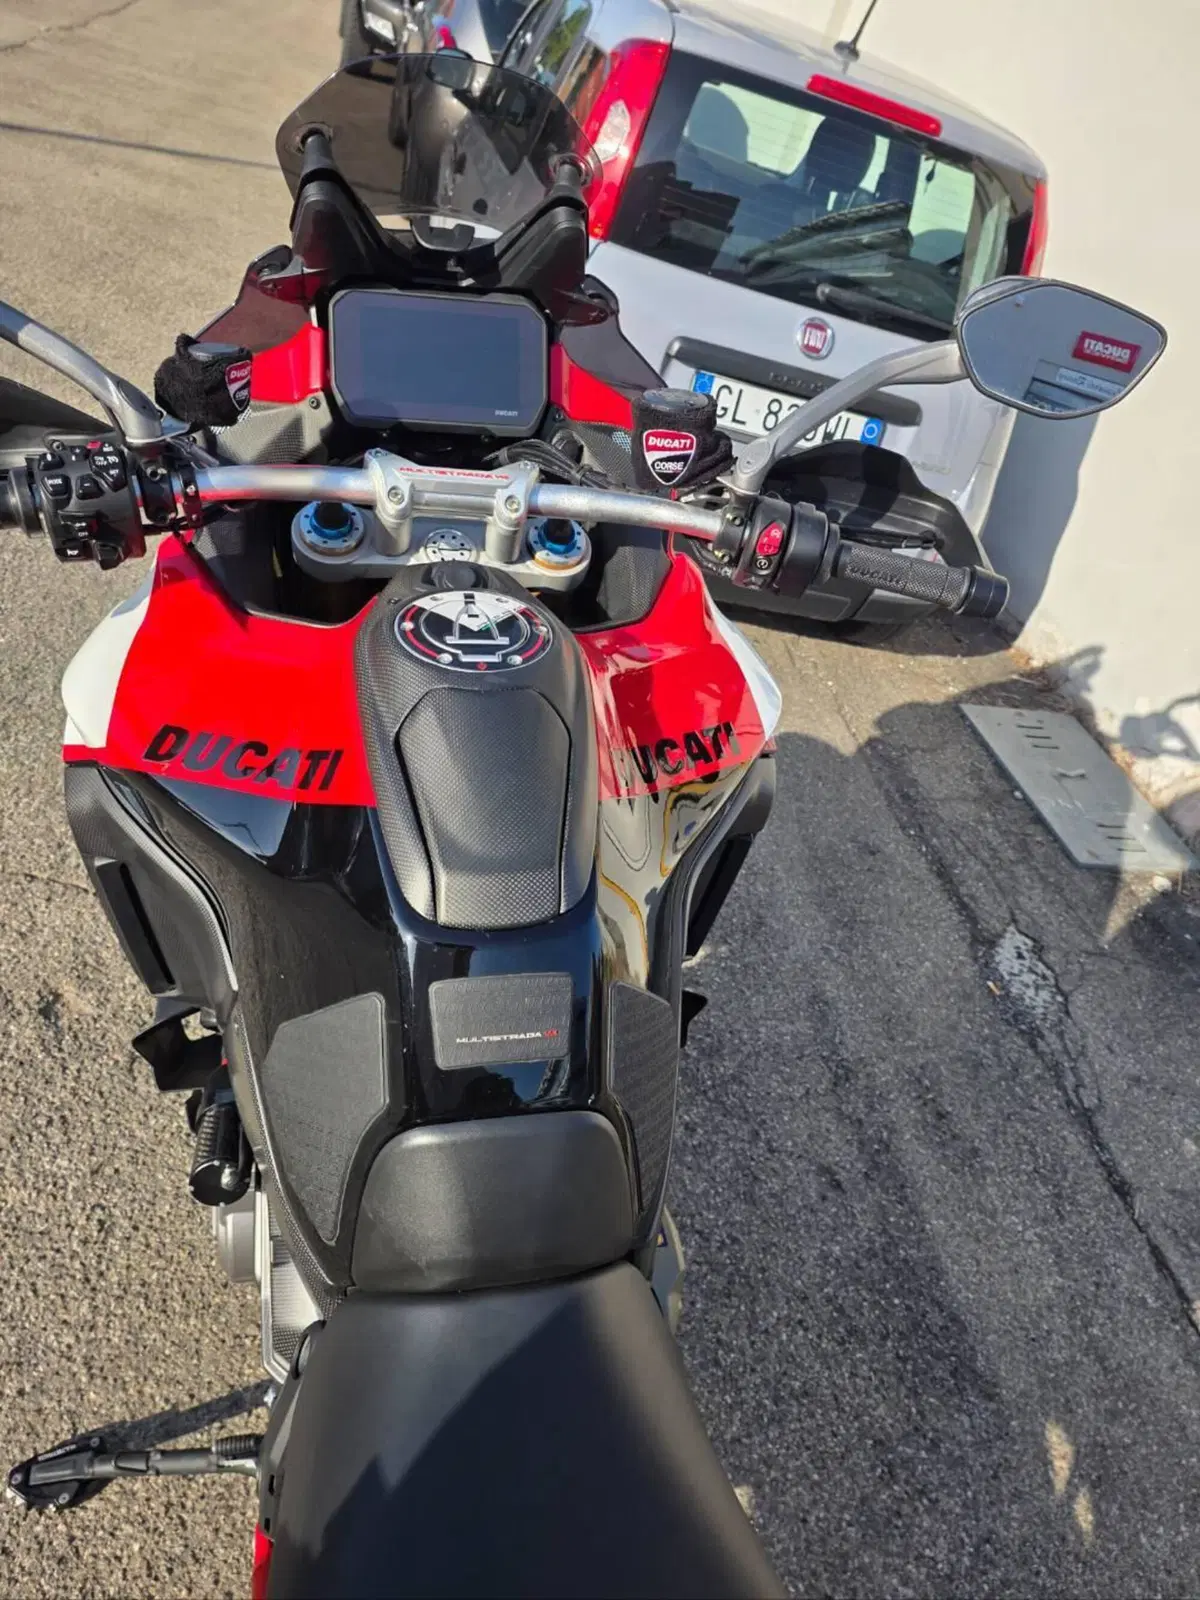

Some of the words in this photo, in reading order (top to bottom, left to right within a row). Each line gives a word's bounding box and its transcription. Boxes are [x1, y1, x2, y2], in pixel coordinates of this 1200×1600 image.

[716, 384, 747, 426] GL
[494, 409, 518, 417] DUCATI
[647, 436, 692, 449] DUCATI
[654, 461, 685, 471] CORSE
[399, 466, 493, 480] MULTISTRADA
[142, 723, 345, 791] DUCATI
[456, 1031, 542, 1043] MULTISTRADA
